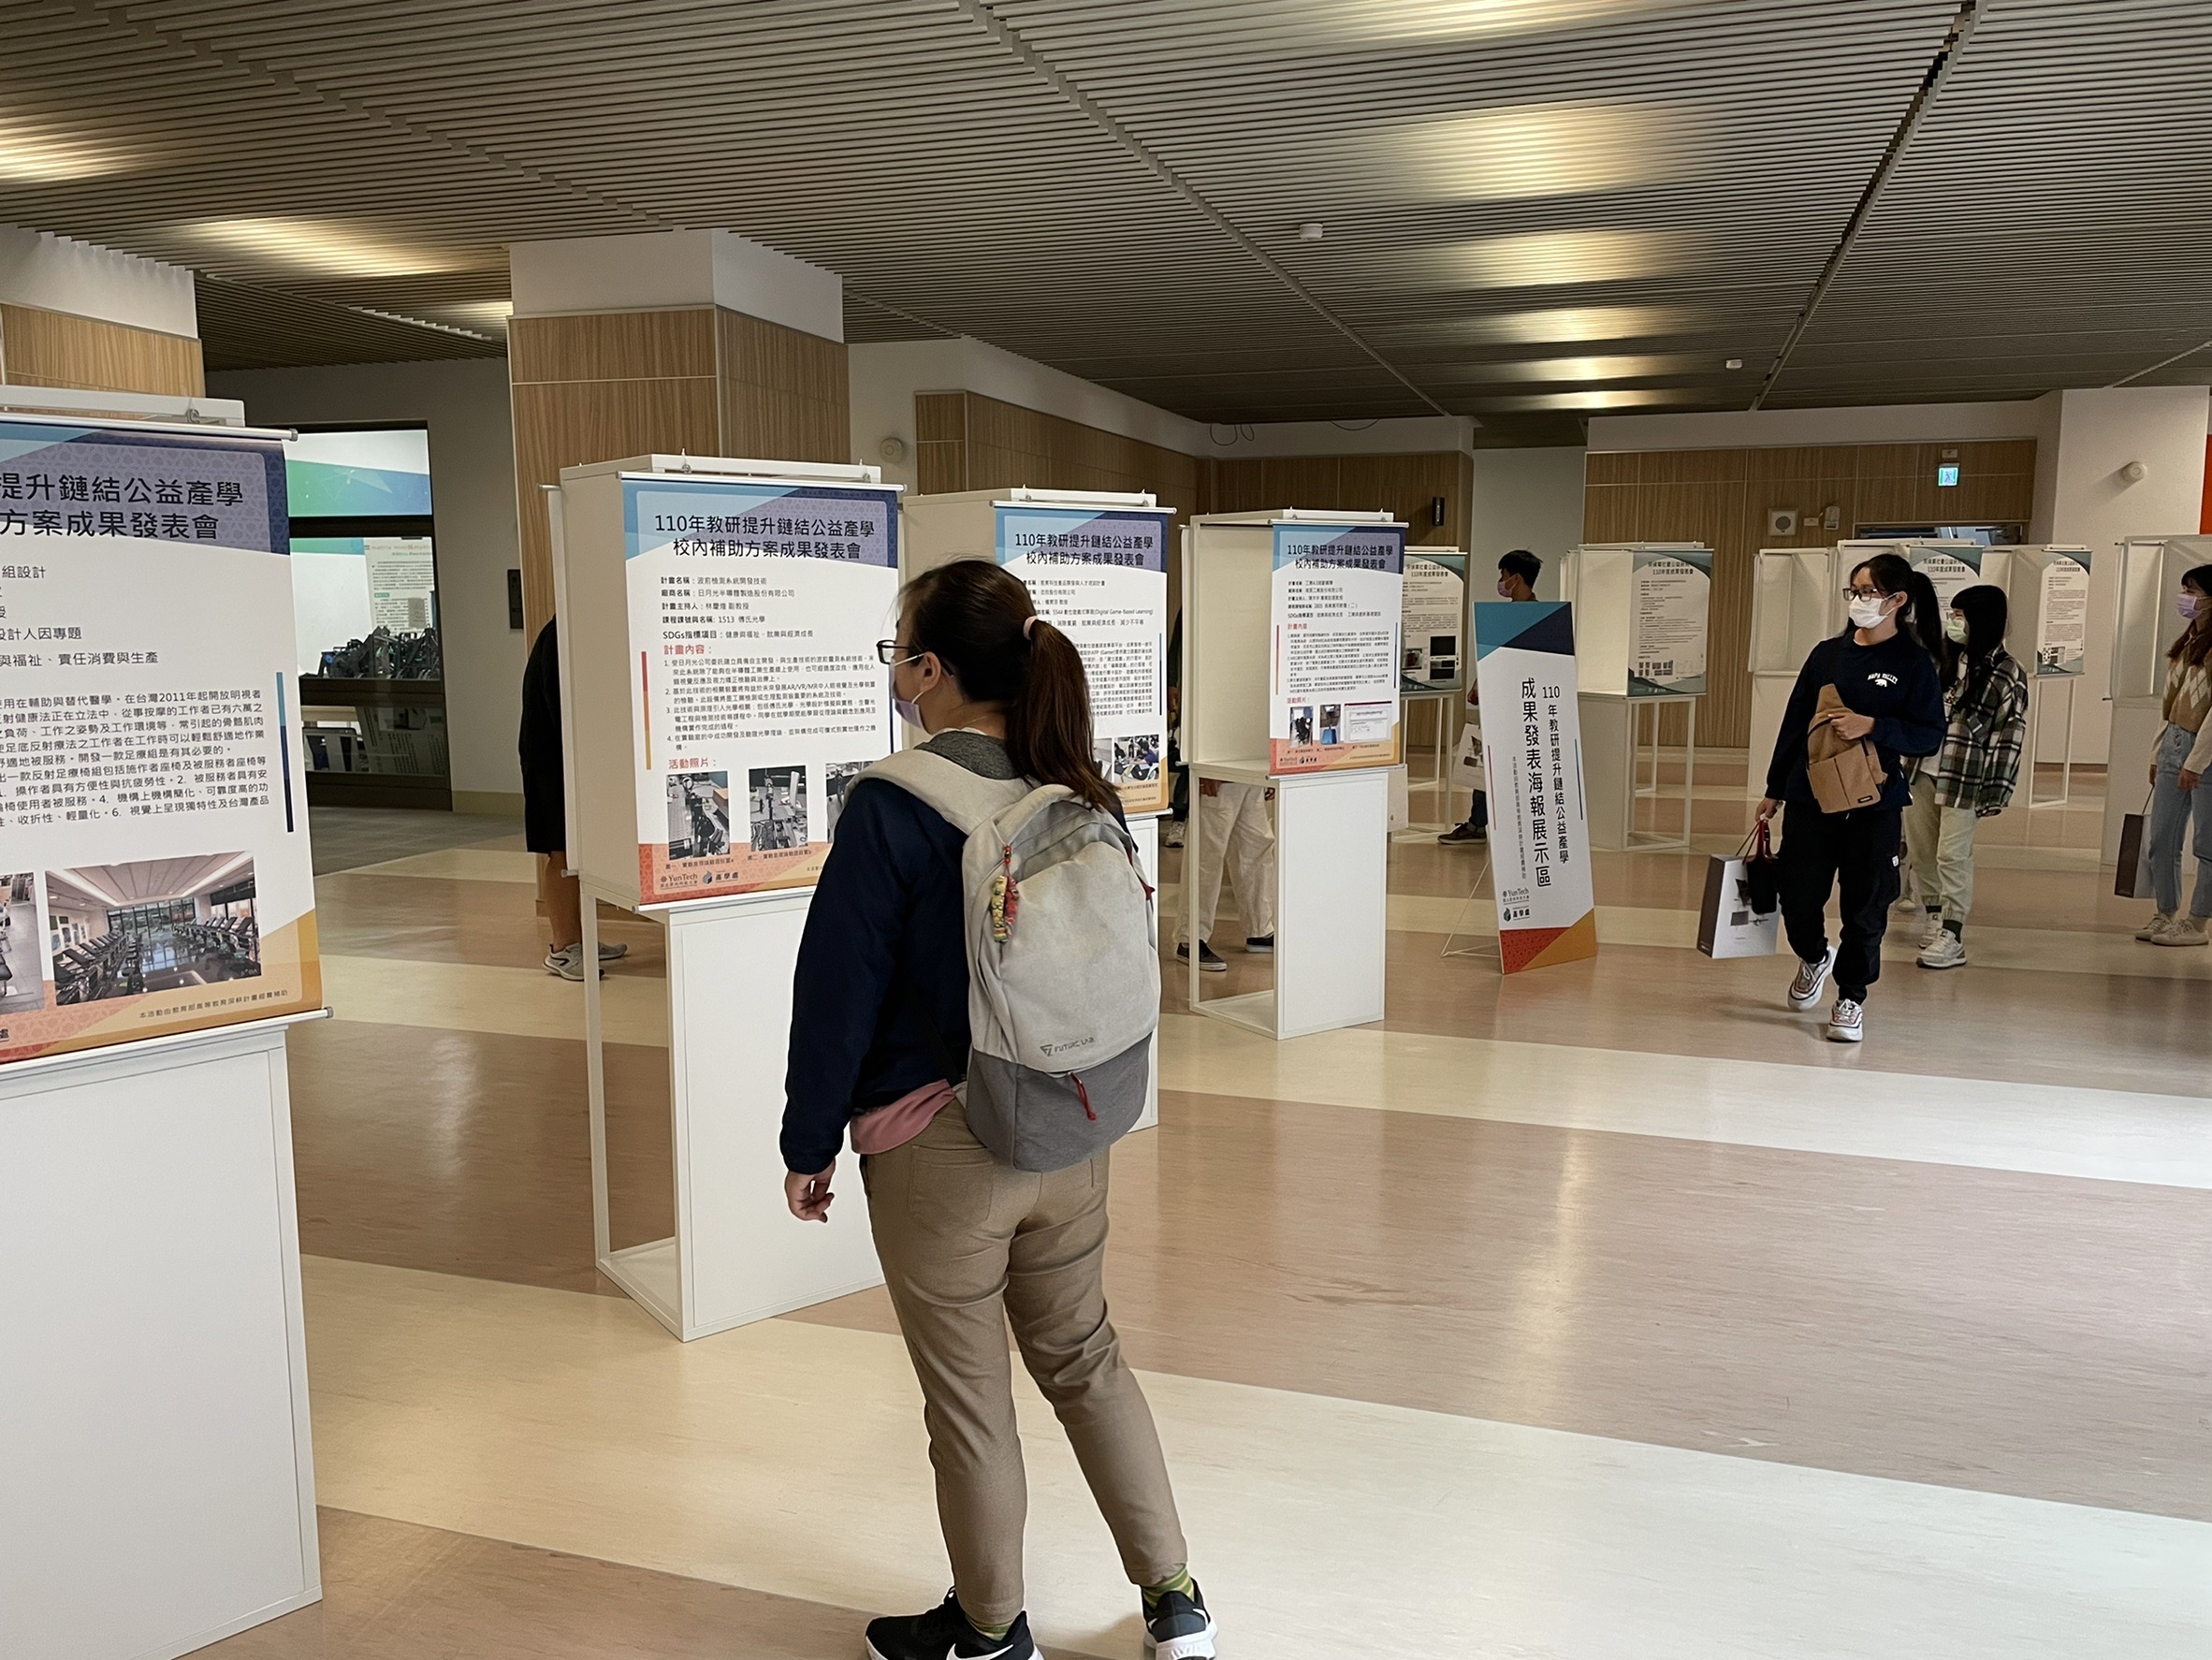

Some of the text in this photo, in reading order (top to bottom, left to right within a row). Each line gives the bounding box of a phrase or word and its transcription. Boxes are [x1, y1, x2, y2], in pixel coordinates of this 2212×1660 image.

[0, 472, 243, 508] 提升鏈結公益產學
[0, 509, 219, 540] 方案成果發表會
[654, 515, 875, 538] 110年教研提升鏈結公益產學
[673, 537, 861, 559] 校內補助方案成果發表會
[1015, 533, 1154, 550] 110年教研提升鏈結公益產學
[1288, 545, 1393, 557] 110年教研提升鏈結公益產學
[1026, 551, 1144, 566] 校內補助方案成果發表會
[1295, 559, 1386, 570] 校內補助方案成果發表會
[2, 565, 46, 579] 組設計
[1521, 677, 1551, 887] 成果發表海報展示區
[1542, 686, 1569, 864] 110年教研提升鏈結公益產學
[668, 873, 698, 881] YunTech
